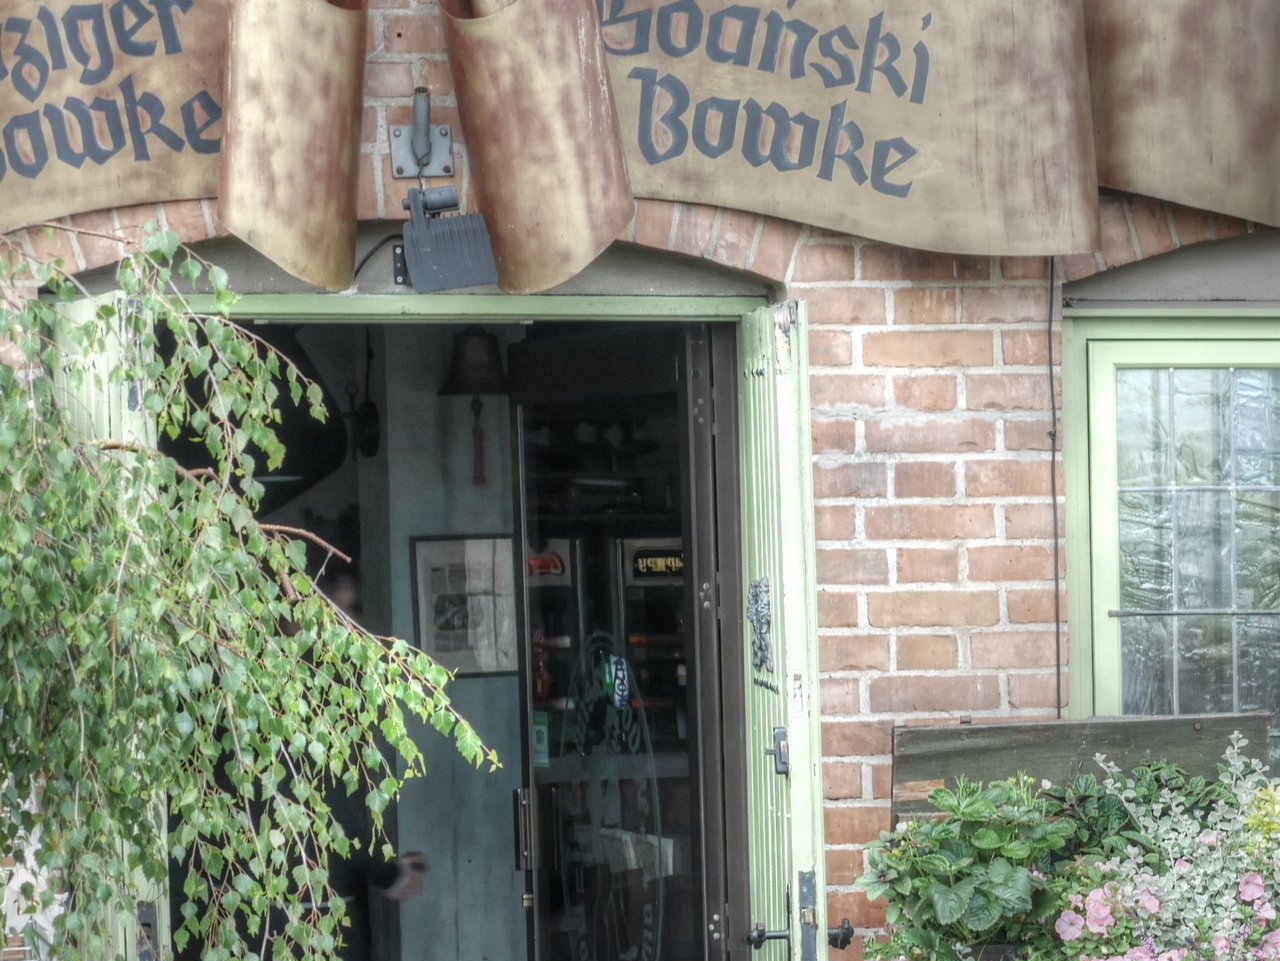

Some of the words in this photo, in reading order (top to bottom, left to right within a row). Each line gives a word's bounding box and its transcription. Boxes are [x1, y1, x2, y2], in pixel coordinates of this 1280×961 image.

[0, 0, 194, 104] ziger
[0, 74, 222, 184] owke
[627, 66, 918, 198] Bowke
